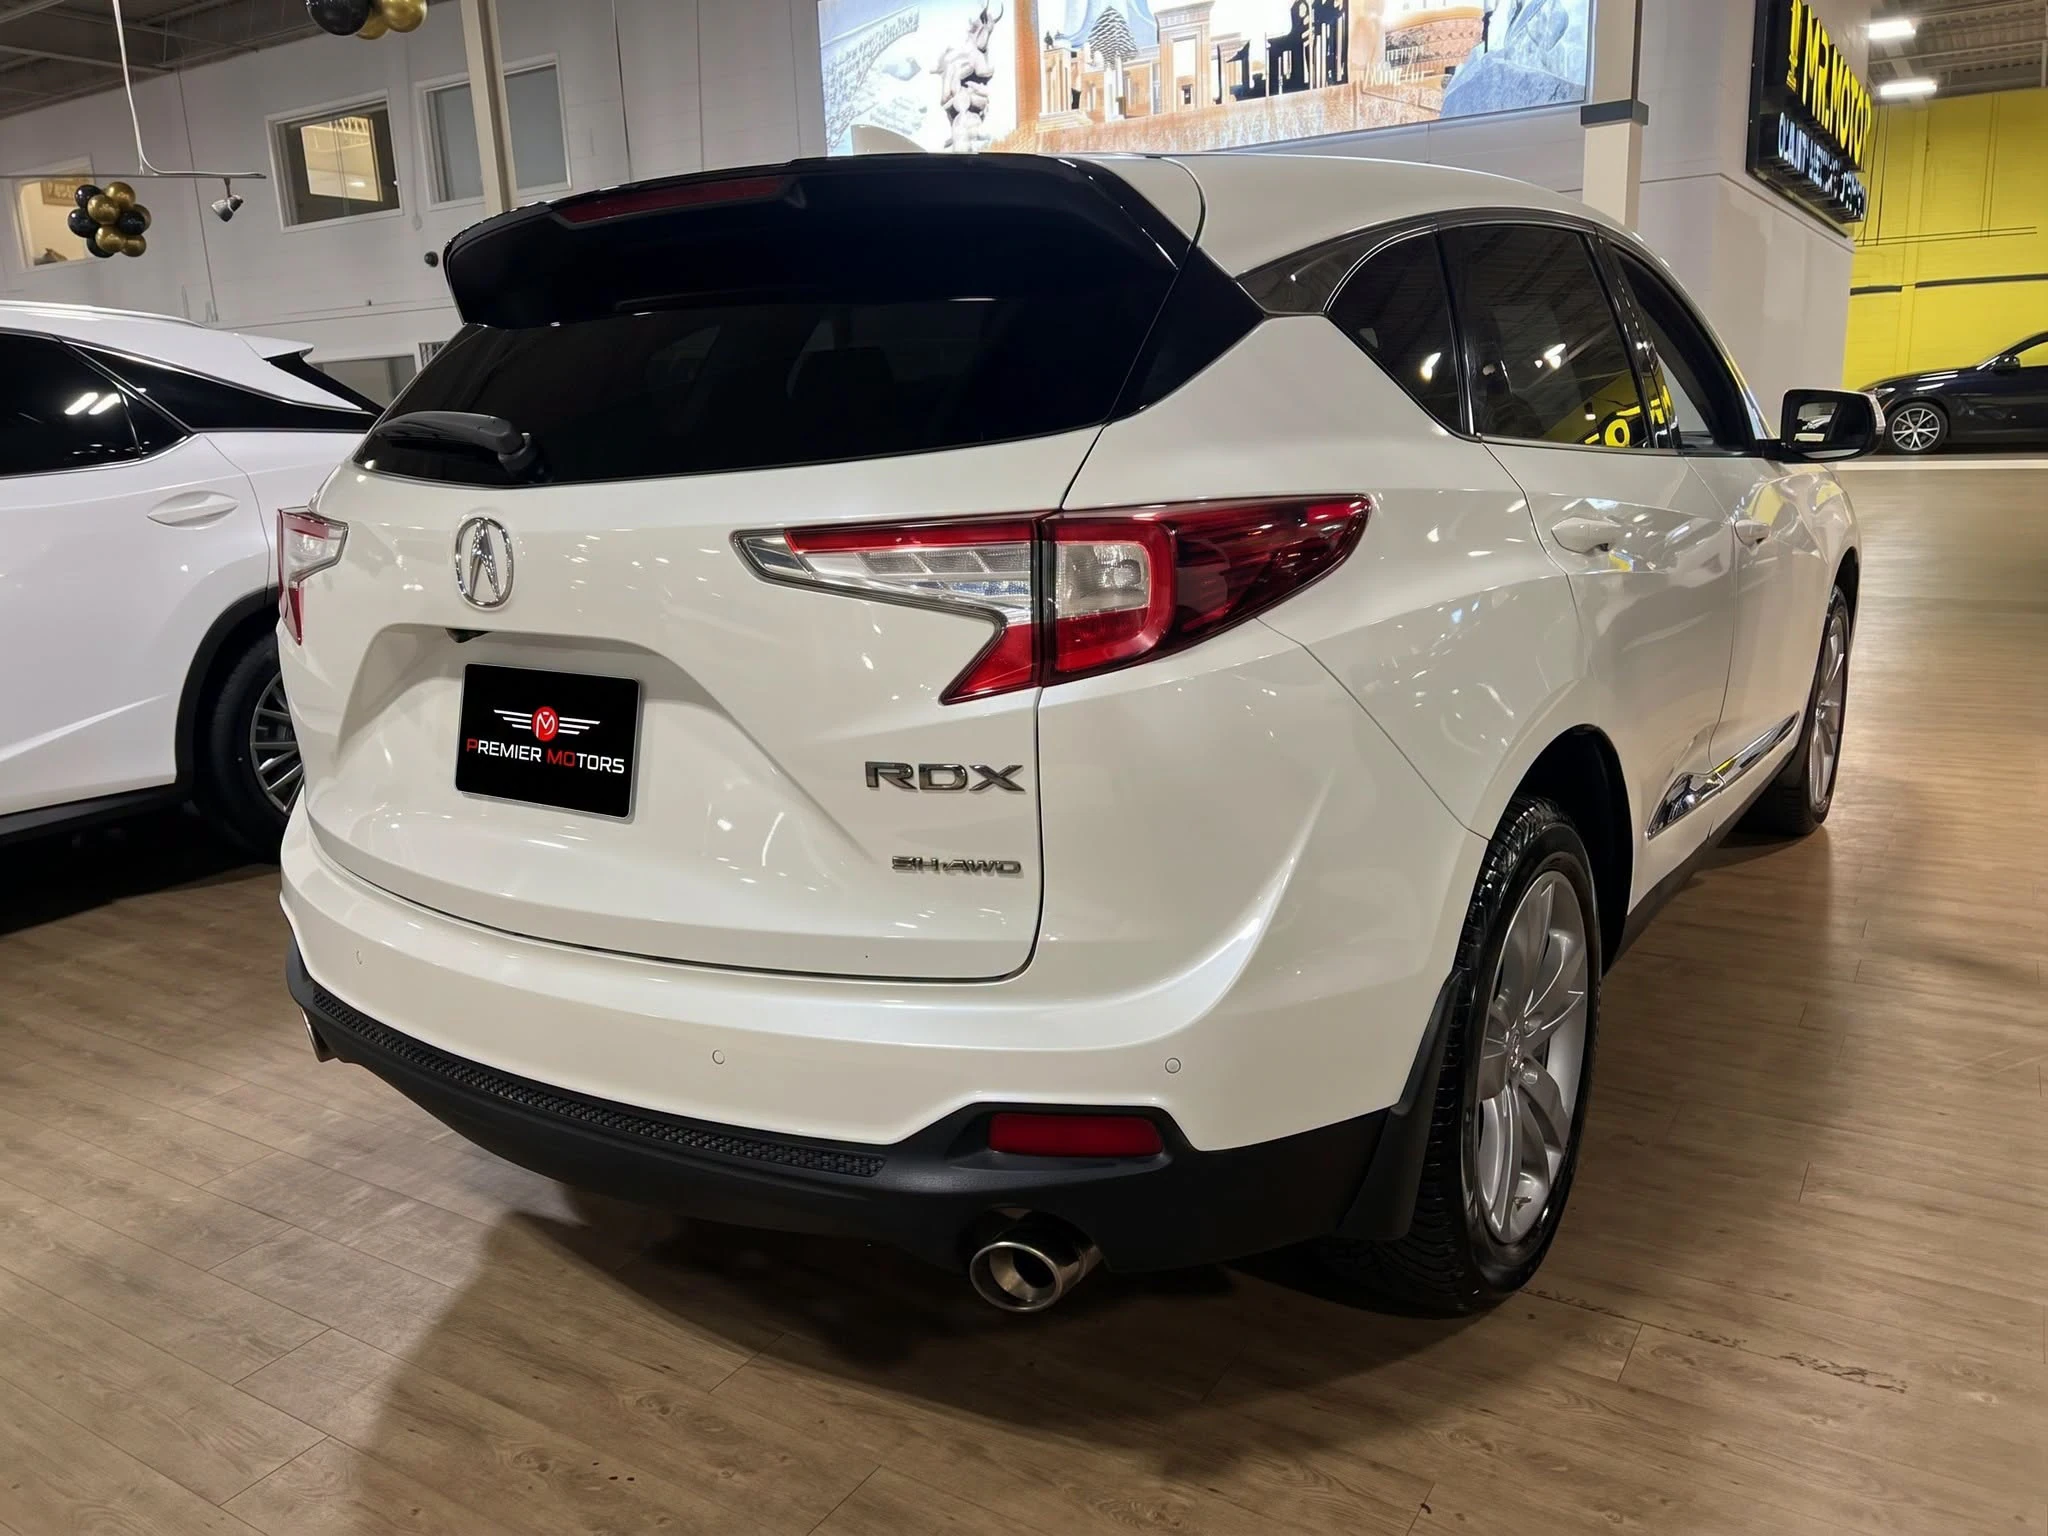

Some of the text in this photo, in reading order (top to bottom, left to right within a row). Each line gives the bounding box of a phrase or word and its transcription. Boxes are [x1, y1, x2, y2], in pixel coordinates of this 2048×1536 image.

[466, 738, 626, 775] PREMIER MOTORS
[865, 761, 1026, 793] RDX
